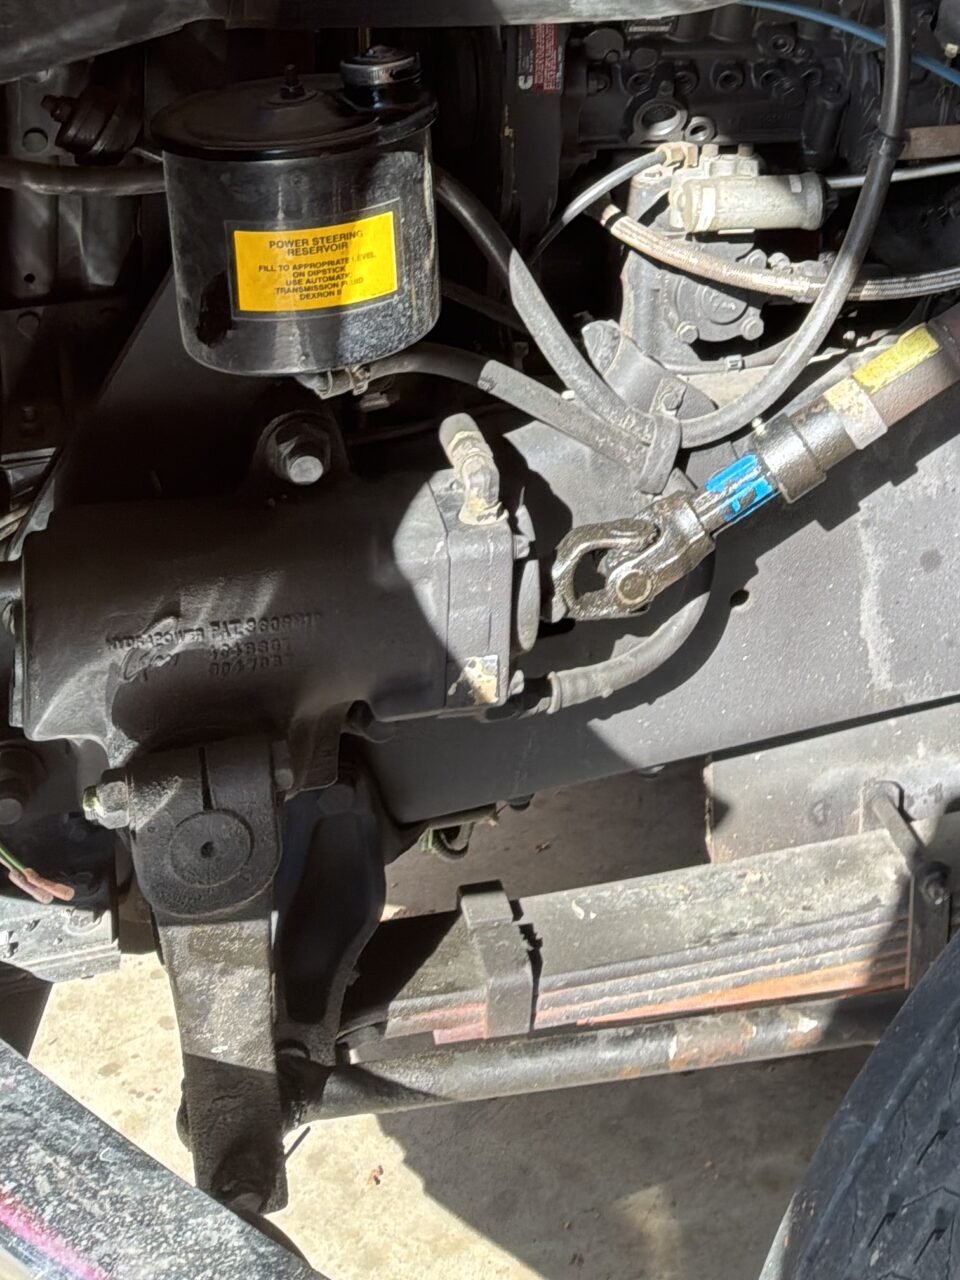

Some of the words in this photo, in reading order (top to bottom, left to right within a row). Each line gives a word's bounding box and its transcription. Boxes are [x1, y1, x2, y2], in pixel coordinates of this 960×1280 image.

[269, 238, 309, 250] POWER
[312, 230, 363, 246] STEERING
[287, 242, 349, 257] RESERVOIR
[258, 265, 276, 273] FILL
[278, 263, 290, 272] TO
[292, 257, 350, 271] APPROPRIATE
[292, 270, 306, 278] ON
[308, 265, 346, 277] DIPSTICK
[275, 282, 339, 295] TRANSMISSION
[341, 276, 364, 289] FUID
[285, 278, 303, 287] USE
[300, 291, 334, 302] DEXRON
